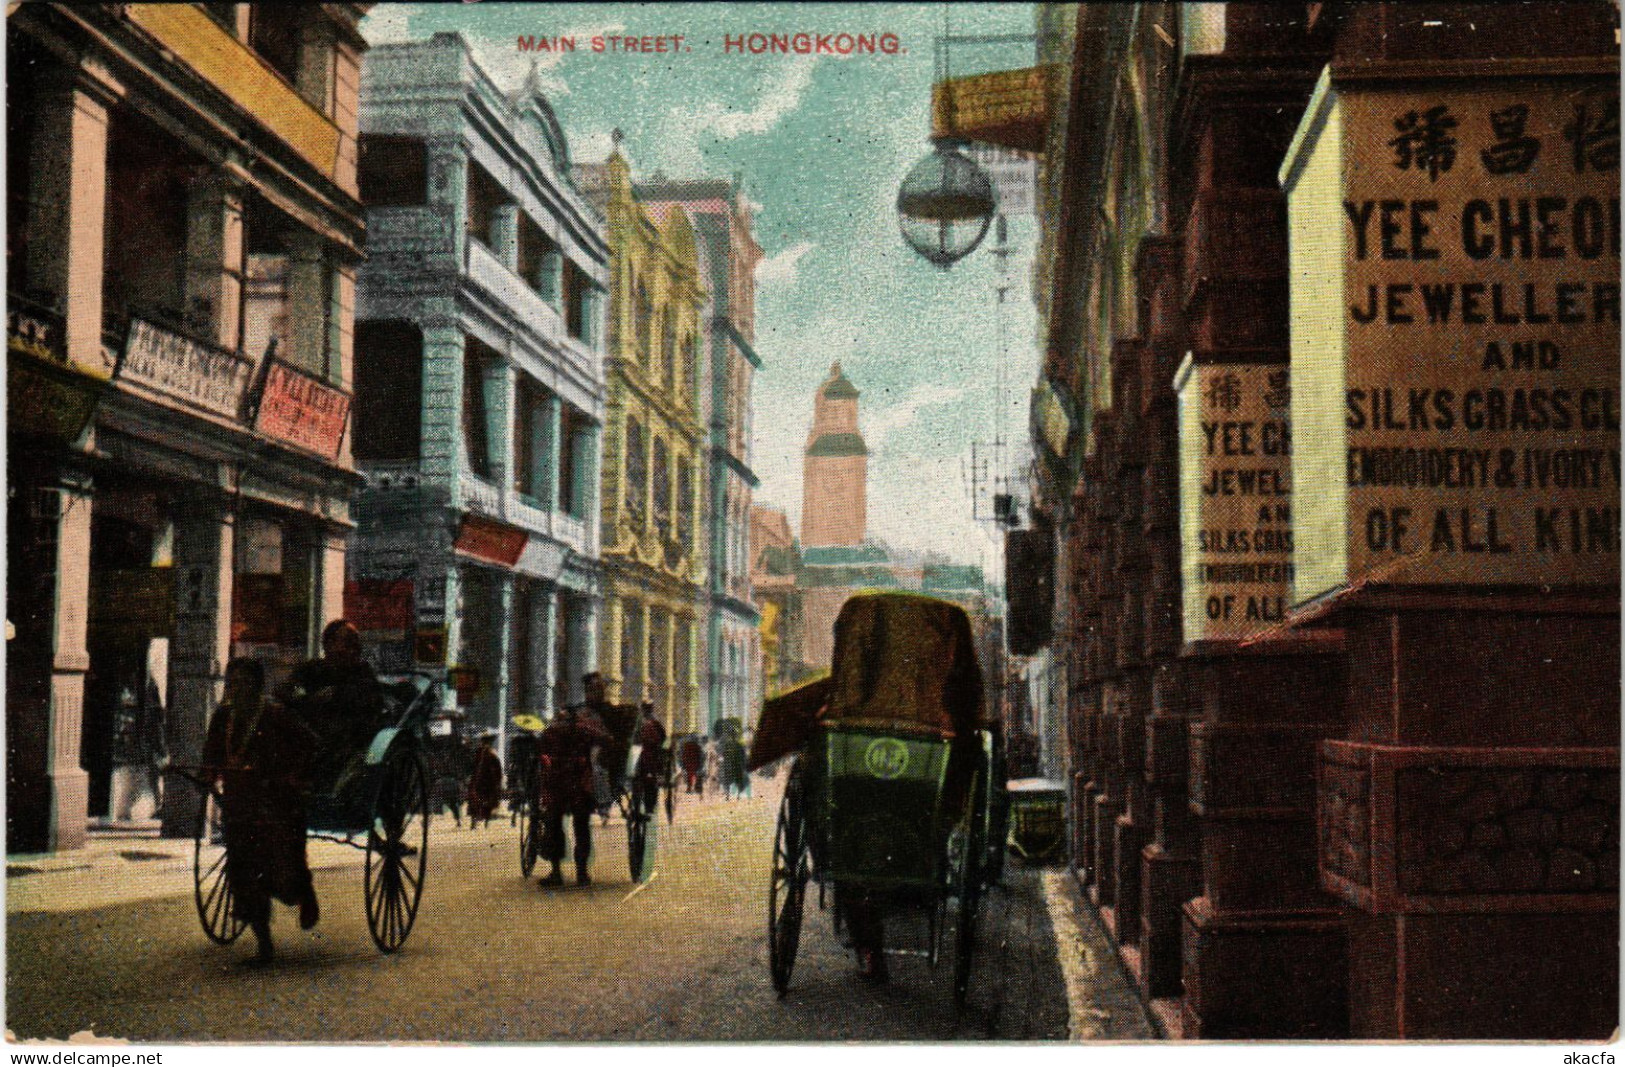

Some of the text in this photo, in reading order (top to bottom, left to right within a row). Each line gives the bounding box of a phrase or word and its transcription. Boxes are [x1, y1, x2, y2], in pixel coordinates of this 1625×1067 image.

[1342, 199, 1440, 261] YEE
[1481, 341, 1561, 371] AND
[1346, 387, 1455, 431] SILKS
[1463, 387, 1573, 431] GRASS
[1201, 421, 1256, 456] YEE
[1199, 529, 1251, 553] SILKS
[1365, 506, 1621, 552] OF ALL KIN
[1206, 595, 1235, 620] OF
